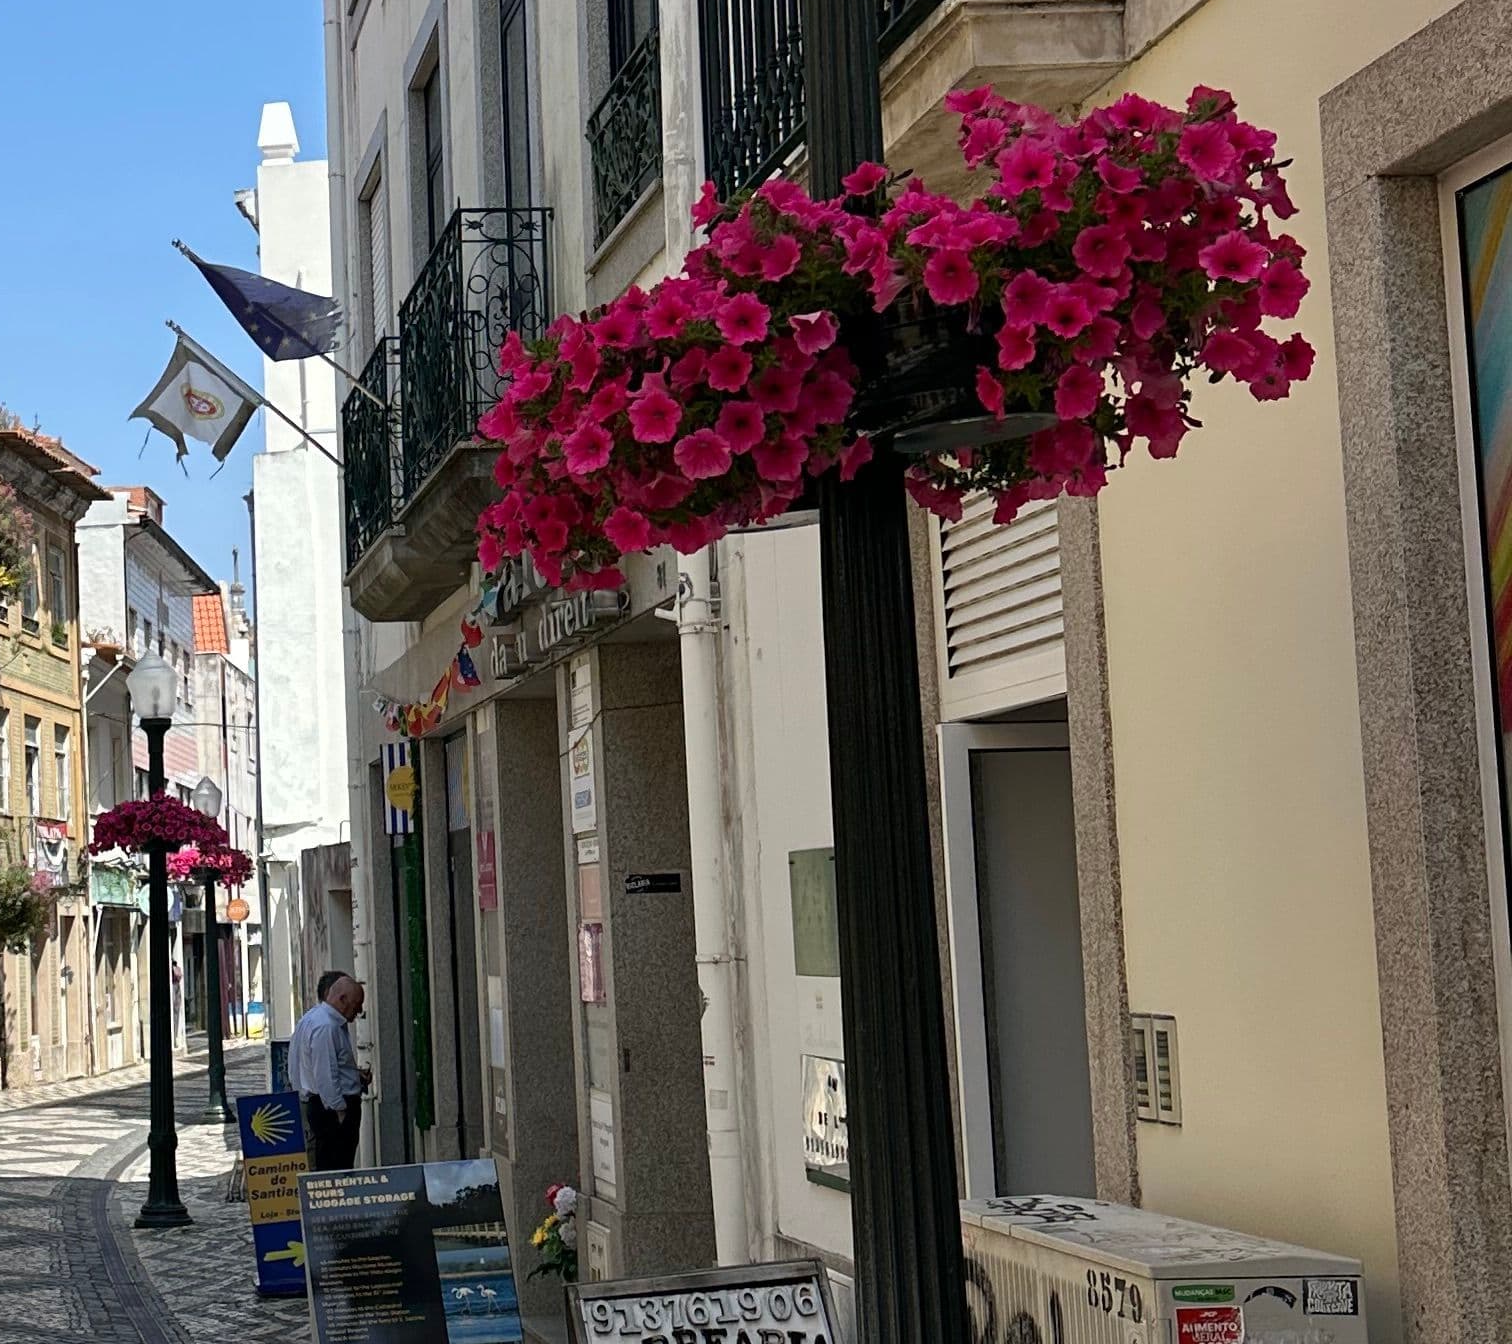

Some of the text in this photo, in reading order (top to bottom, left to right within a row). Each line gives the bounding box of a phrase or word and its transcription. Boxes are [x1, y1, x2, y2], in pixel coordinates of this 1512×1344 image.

[248, 1161, 306, 1176] Caminho
[270, 1175, 287, 1185] de
[306, 1175, 388, 1190] BIKE RENTAL &
[308, 1189, 345, 1199] TOURS
[309, 1192, 416, 1209] LUGGAGE STORAGE
[1087, 1268, 1144, 1324] 8579
[591, 1284, 818, 1336] 913761906
[1182, 1322, 1238, 1333] AUMENTO
